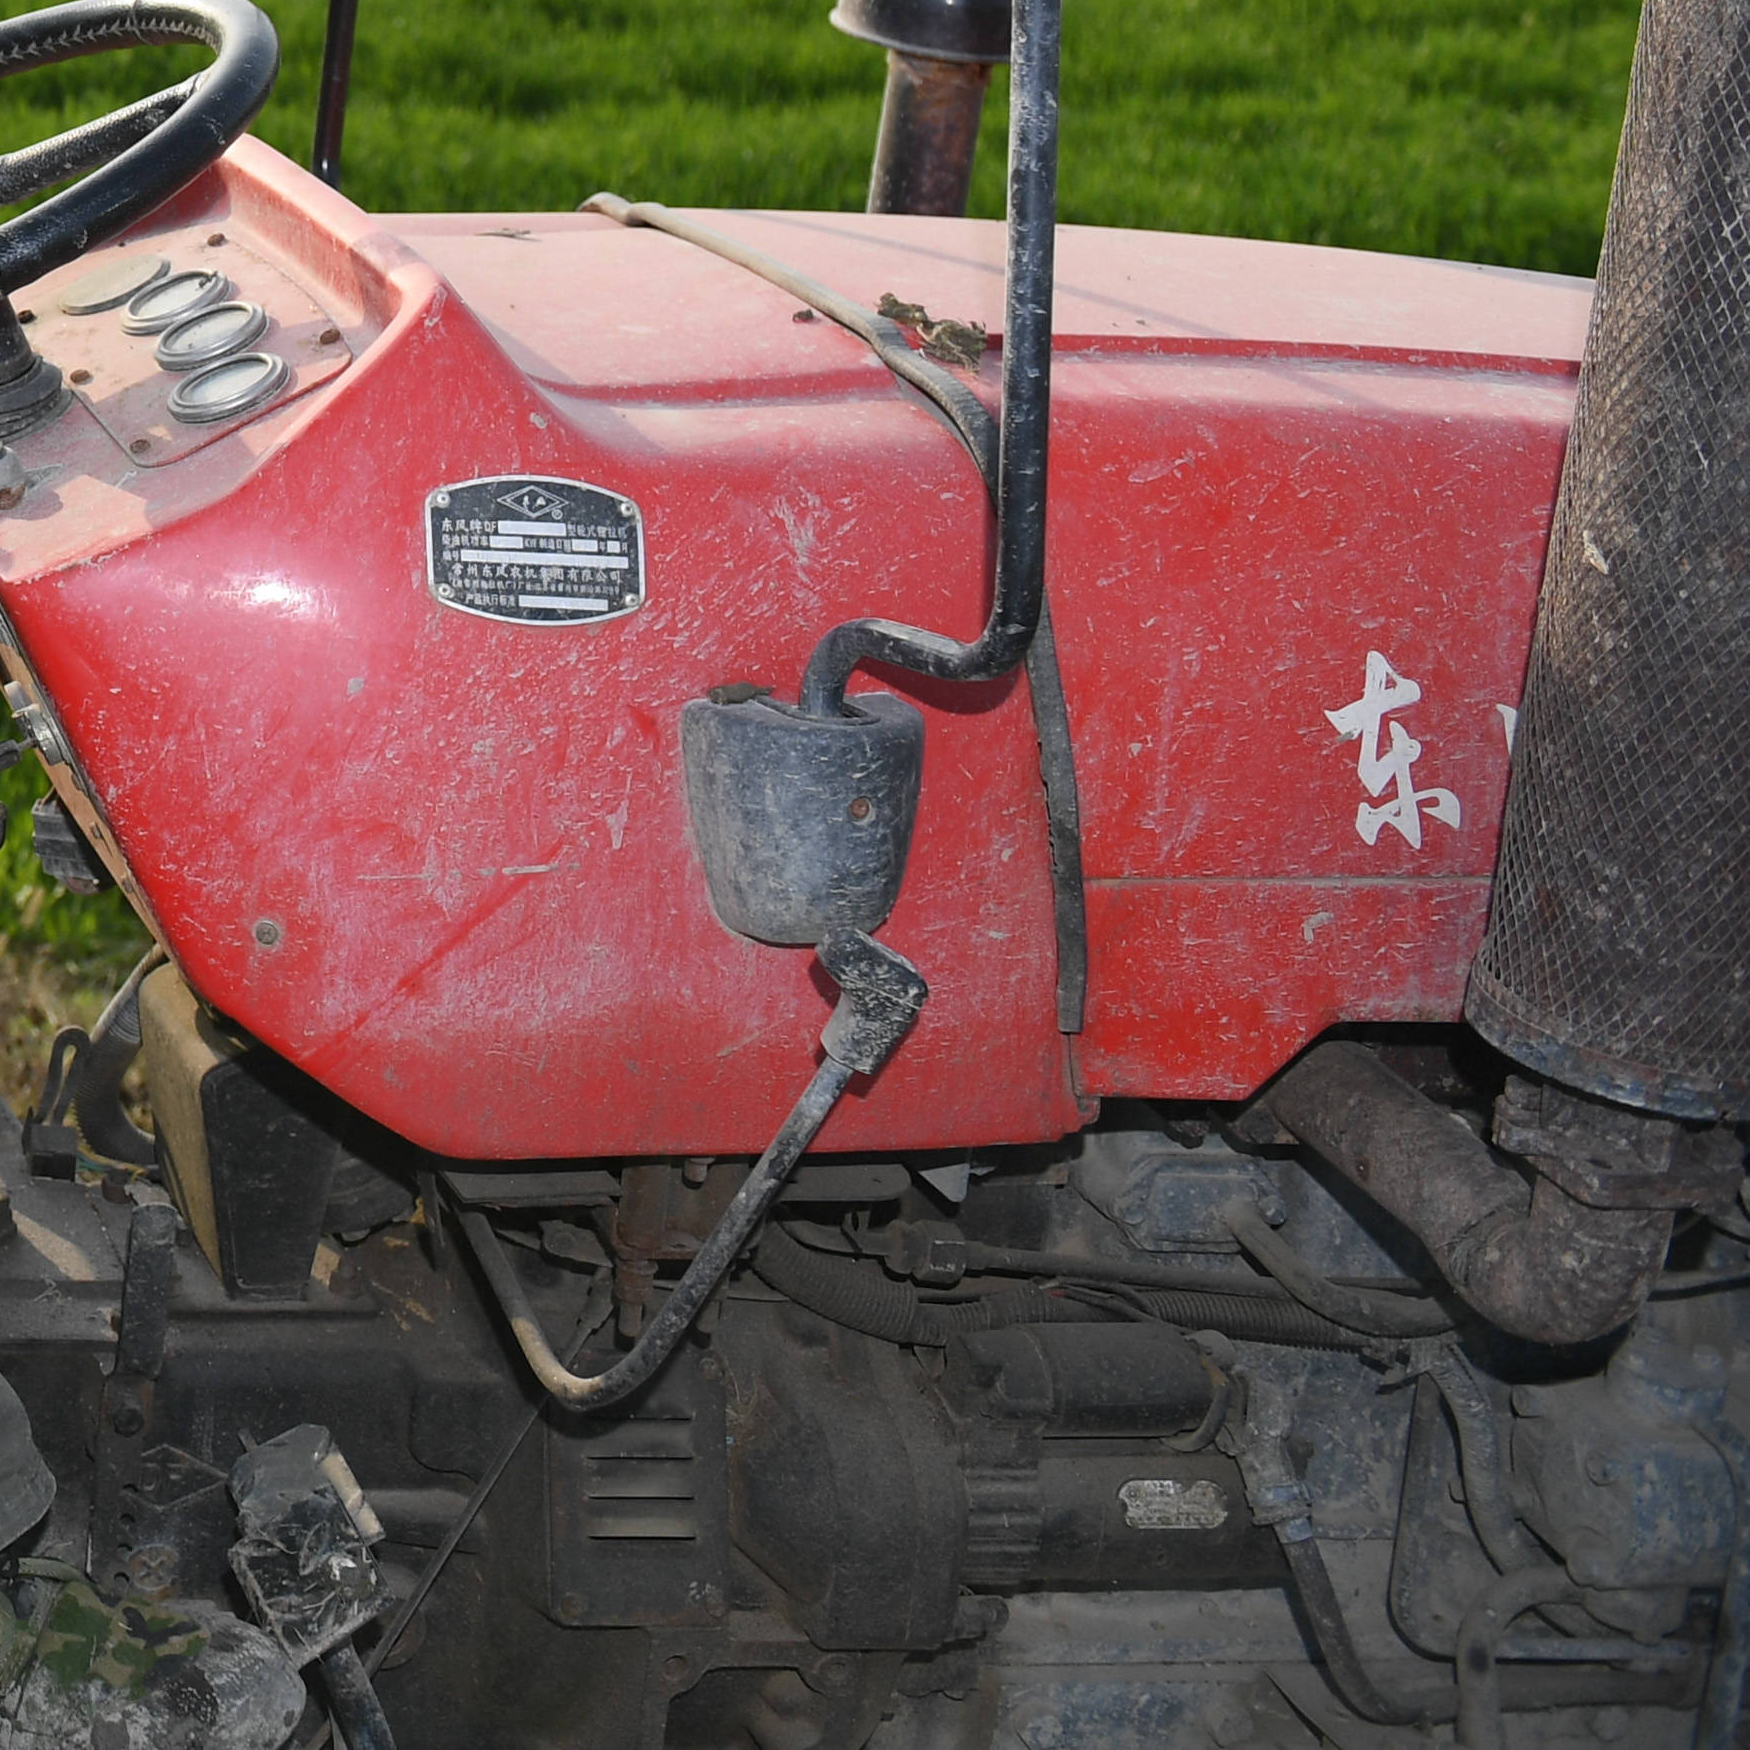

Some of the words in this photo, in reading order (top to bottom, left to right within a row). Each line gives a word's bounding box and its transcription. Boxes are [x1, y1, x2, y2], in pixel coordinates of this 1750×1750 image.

[451, 562, 621, 583] 常州东风农机集团有限公司
[1323, 649, 1517, 850] 东
